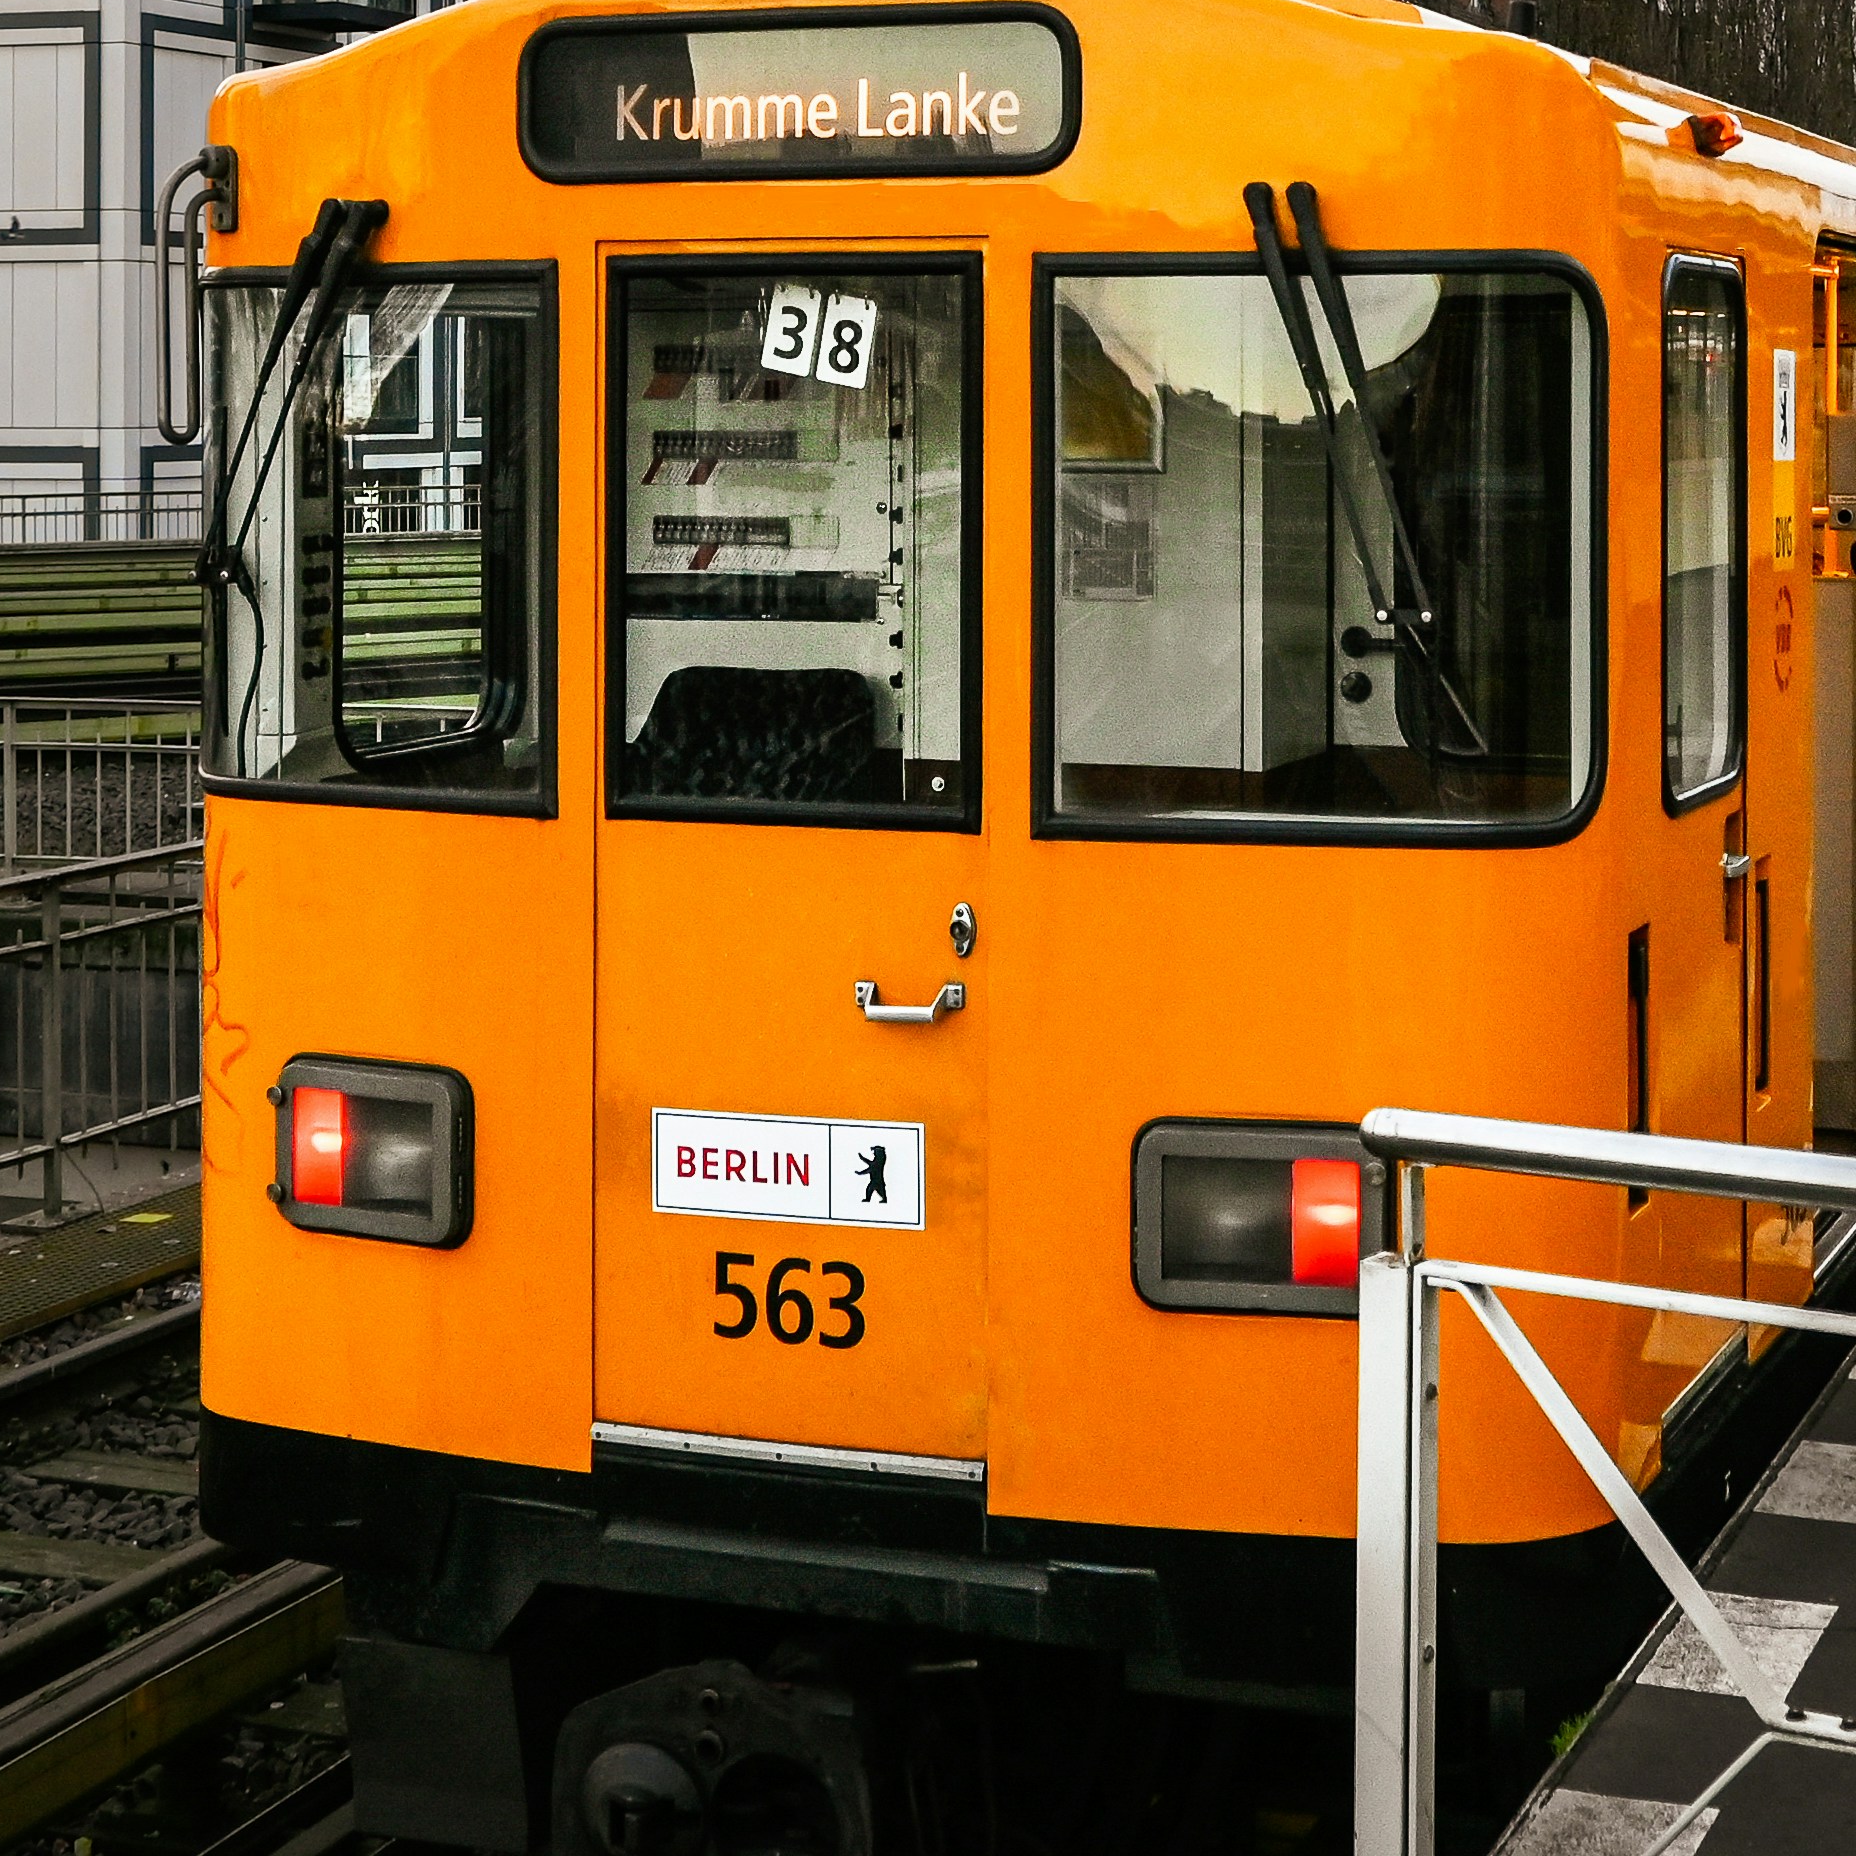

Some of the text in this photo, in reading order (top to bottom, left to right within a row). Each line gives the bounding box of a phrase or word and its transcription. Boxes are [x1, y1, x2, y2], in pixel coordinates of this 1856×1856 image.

[616, 71, 1020, 141] Krumme Lanke
[772, 305, 863, 374] 38
[1775, 515, 1793, 559] BVG
[677, 1145, 810, 1186] BERLIN
[713, 1250, 866, 1350] 563
